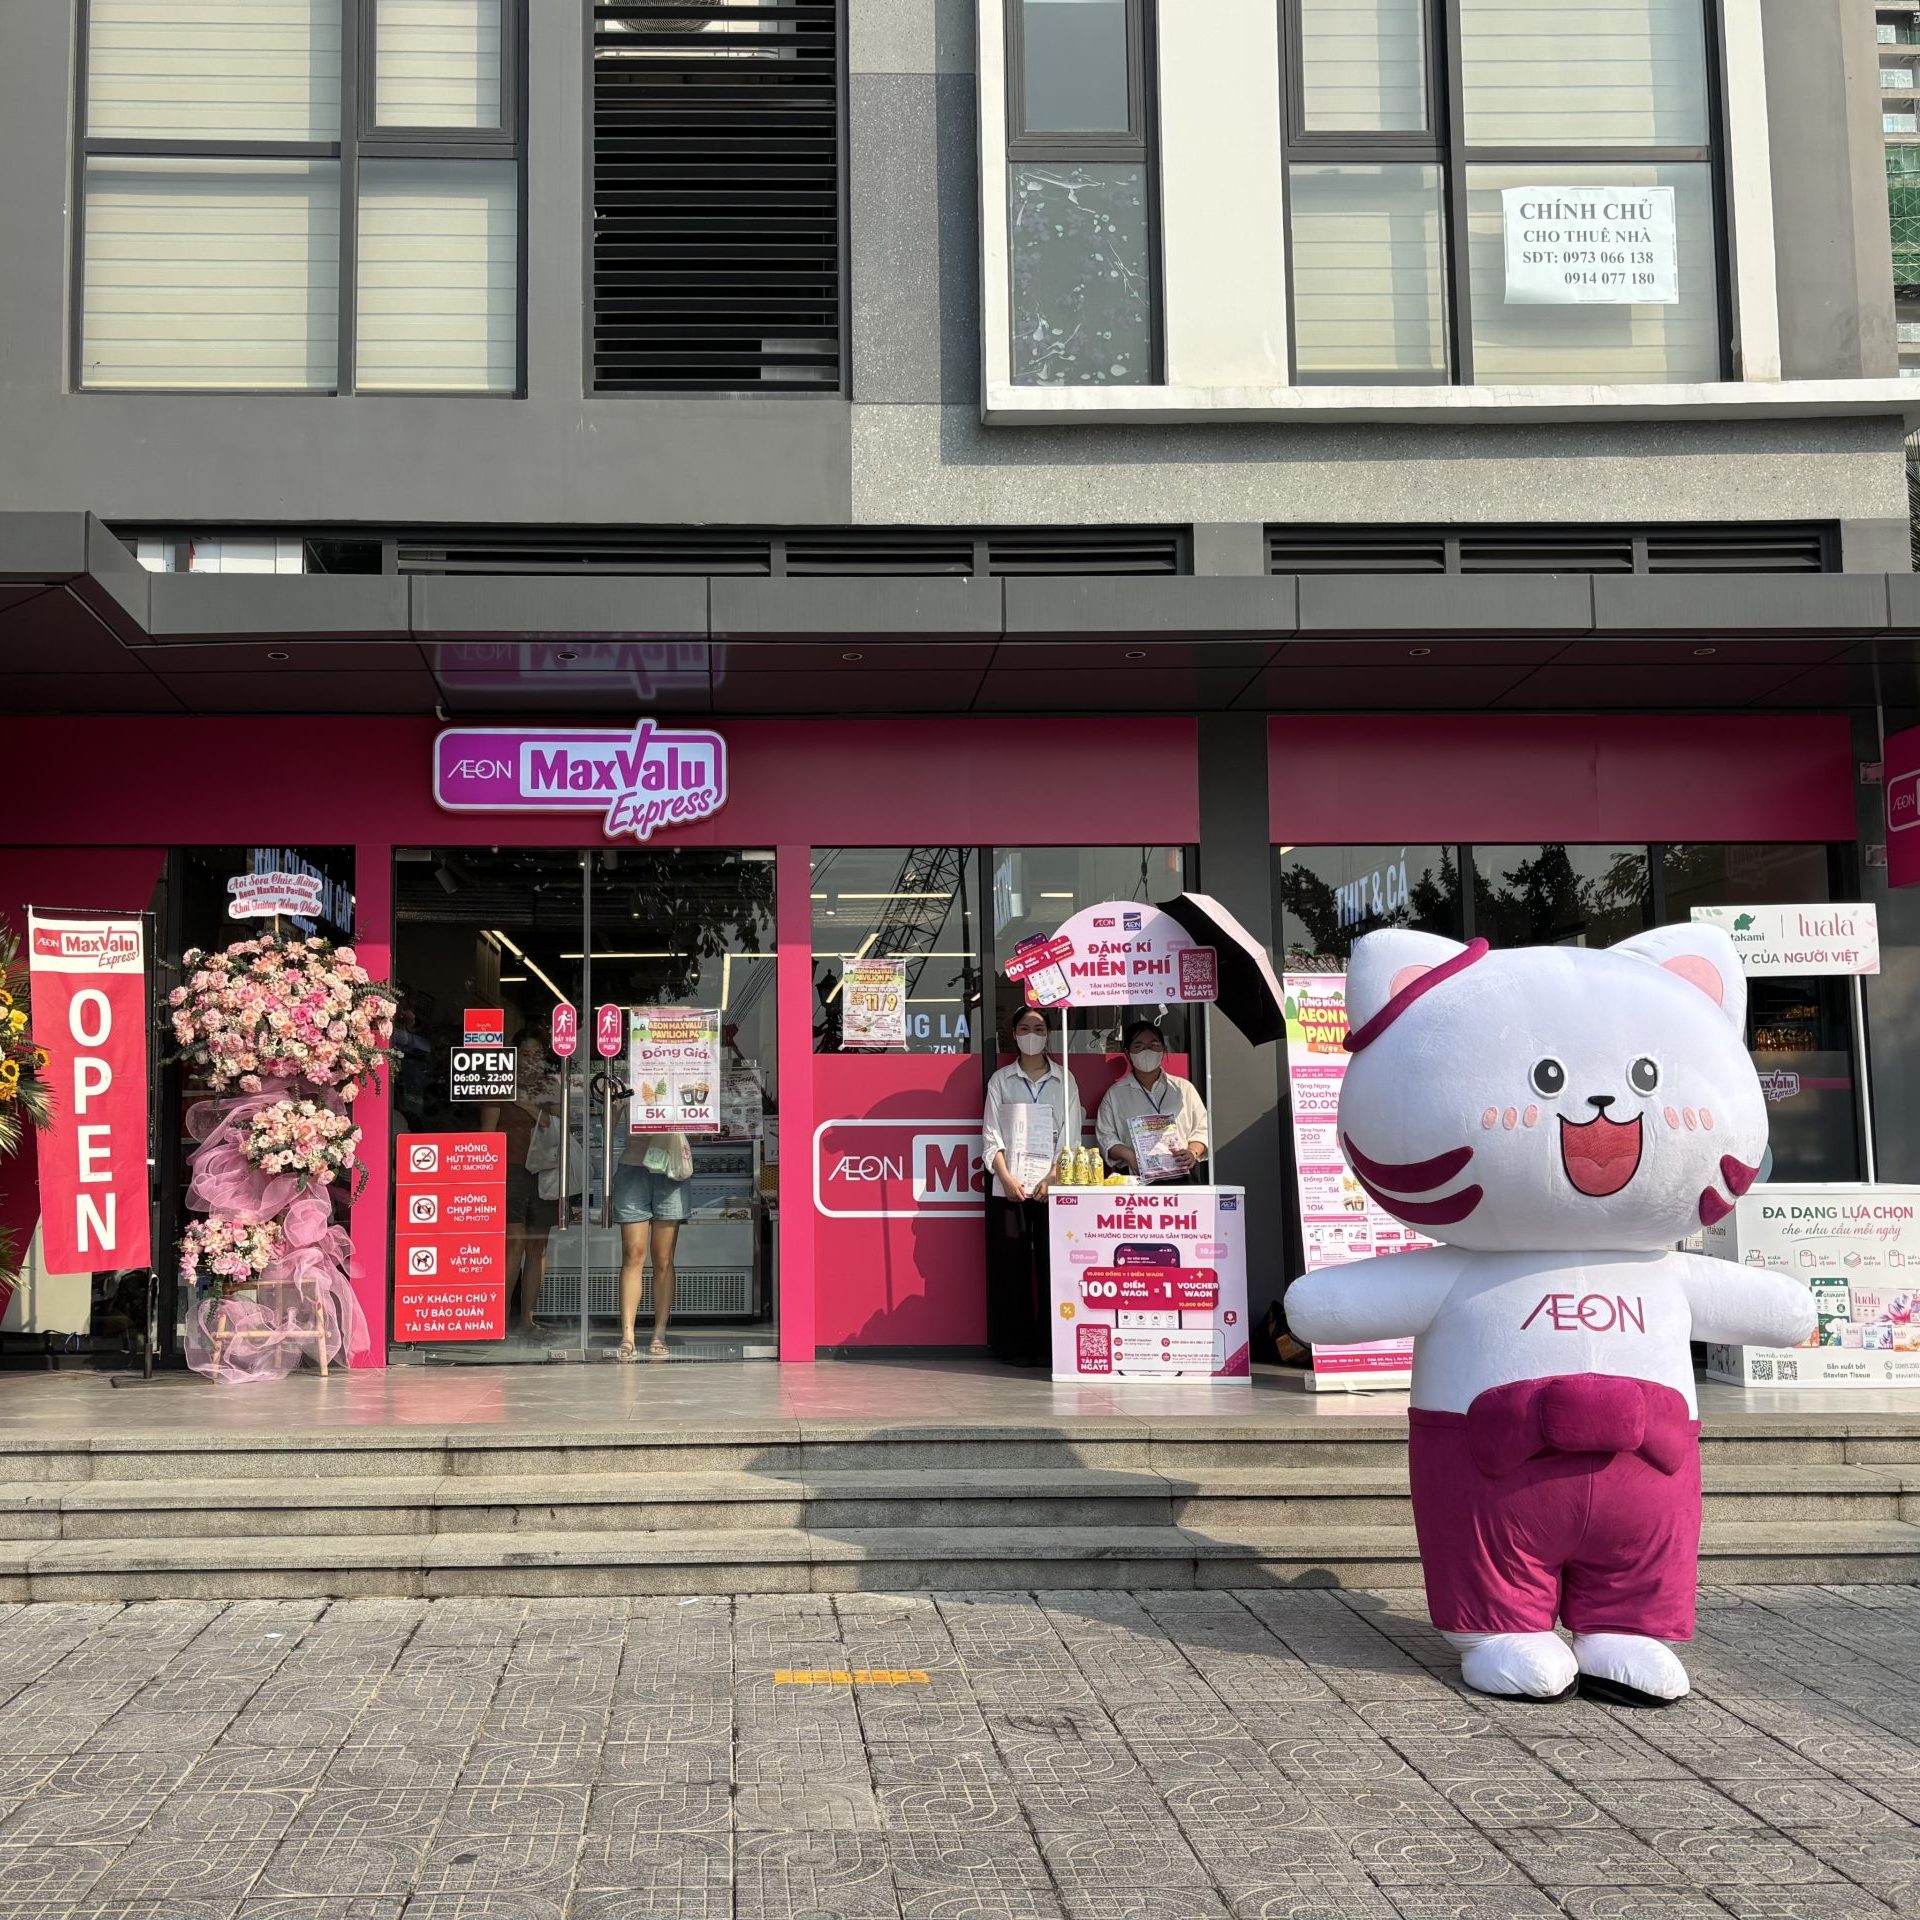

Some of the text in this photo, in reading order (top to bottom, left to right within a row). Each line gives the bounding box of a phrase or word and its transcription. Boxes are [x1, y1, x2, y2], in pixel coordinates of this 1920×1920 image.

[1520, 199, 1652, 220] CHÍNH CHỦ
[1523, 227, 1651, 243] CHO THUÊ NHÀ
[1523, 251, 1654, 264] SĐT: 0973 066 138
[1564, 272, 1655, 285] 0914 077 180
[530, 723, 706, 791] MaxValu
[608, 788, 714, 836] Express
[249, 873, 269, 887] Sora
[271, 873, 293, 886] Chúc
[286, 887, 313, 899] Pavilion
[1730, 913, 1855, 942] takami luala
[65, 926, 134, 951] MaxValu
[1088, 939, 1152, 954] ĐĂNG KÍ
[98, 951, 137, 969] Express
[1751, 949, 1859, 965] CỦA NGƯỜI VIỆT
[1070, 953, 1172, 977] MIỄN PHÍ
[865, 993, 898, 1012] 11/9
[1298, 1008, 1336, 1023] AEON
[464, 1033, 503, 1043] SECOM
[652, 1031, 688, 1039] PAVILION
[453, 1053, 514, 1071] OPEN
[454, 1073, 514, 1082] 06:00 22:00
[454, 1084, 514, 1095] EVERYDAY
[1299, 1100, 1338, 1109] 20.00
[68, 989, 116, 1252] OPEN
[646, 1108, 711, 1119] 5K 10K
[454, 1143, 488, 1153] KHÔNG
[446, 1152, 498, 1163] HÚT THUỐC
[454, 1194, 487, 1203] KHÔNG
[1115, 1193, 1178, 1207] ĐĂNG KÍ
[446, 1204, 497, 1215] CHỤP HÌNH
[1762, 1204, 1913, 1222] ĐA DẠNG LỰA CHỌN
[1097, 1207, 1198, 1230] MIỄN PHÍ
[1123, 1232, 1139, 1240] DỊCH
[1782, 1223, 1901, 1242] cho nhu cầu mỗi ngày
[450, 1256, 492, 1266] VẬT NUÔI
[1079, 1281, 1172, 1298] 100 1
[1123, 1280, 1219, 1290] ĐIỂM VOUCHER
[402, 1292, 497, 1304] QUÝ KHÁCH CHÚ Ý
[415, 1305, 484, 1319] TỰ BẢO QUẢN
[405, 1320, 494, 1331] TÀI SẢN CÁ NHÂN
